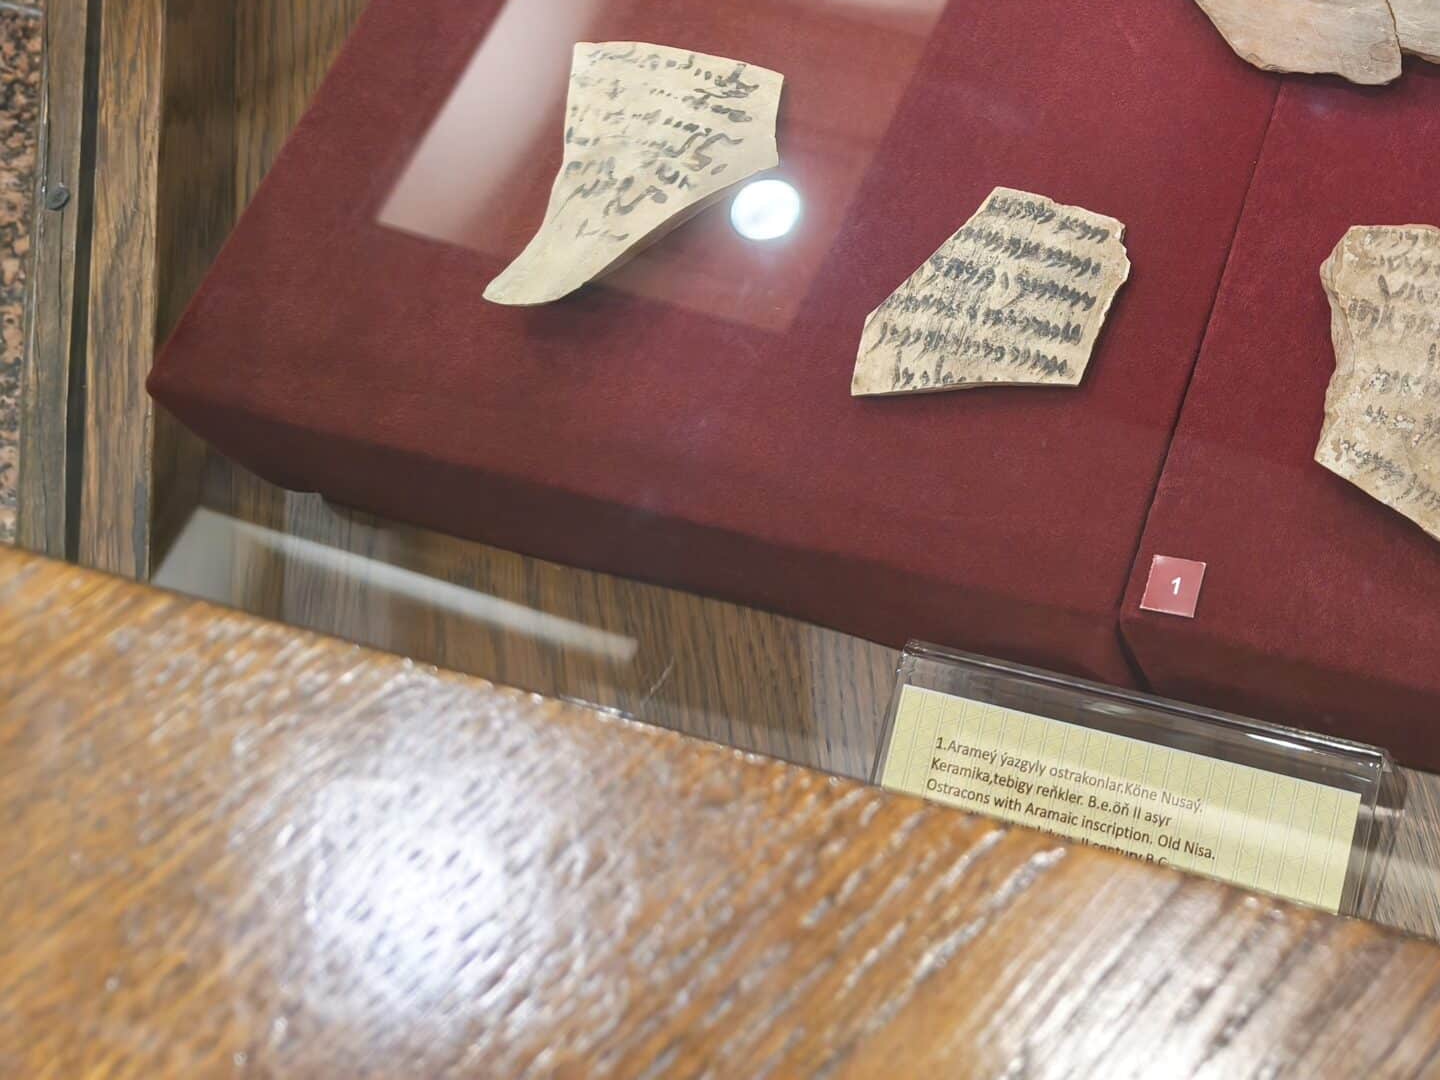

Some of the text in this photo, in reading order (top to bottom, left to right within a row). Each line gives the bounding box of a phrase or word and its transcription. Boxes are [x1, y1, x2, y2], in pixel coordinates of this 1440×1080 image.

[1171, 577, 1182, 596] 1
[931, 756, 1034, 796] Keramika,tebigy
[1035, 784, 1085, 806] reňkler.
[1132, 805, 1142, 820] II
[1143, 811, 1173, 828] asyr
[1160, 790, 1203, 815] Nusaý.
[926, 778, 991, 805] Ostracons
[993, 796, 1022, 812] with
[1023, 802, 1079, 827] Aramaic
[1080, 815, 1154, 845] inscription.
[1157, 834, 1181, 852] Old
[1183, 840, 1216, 860] Nisa.
